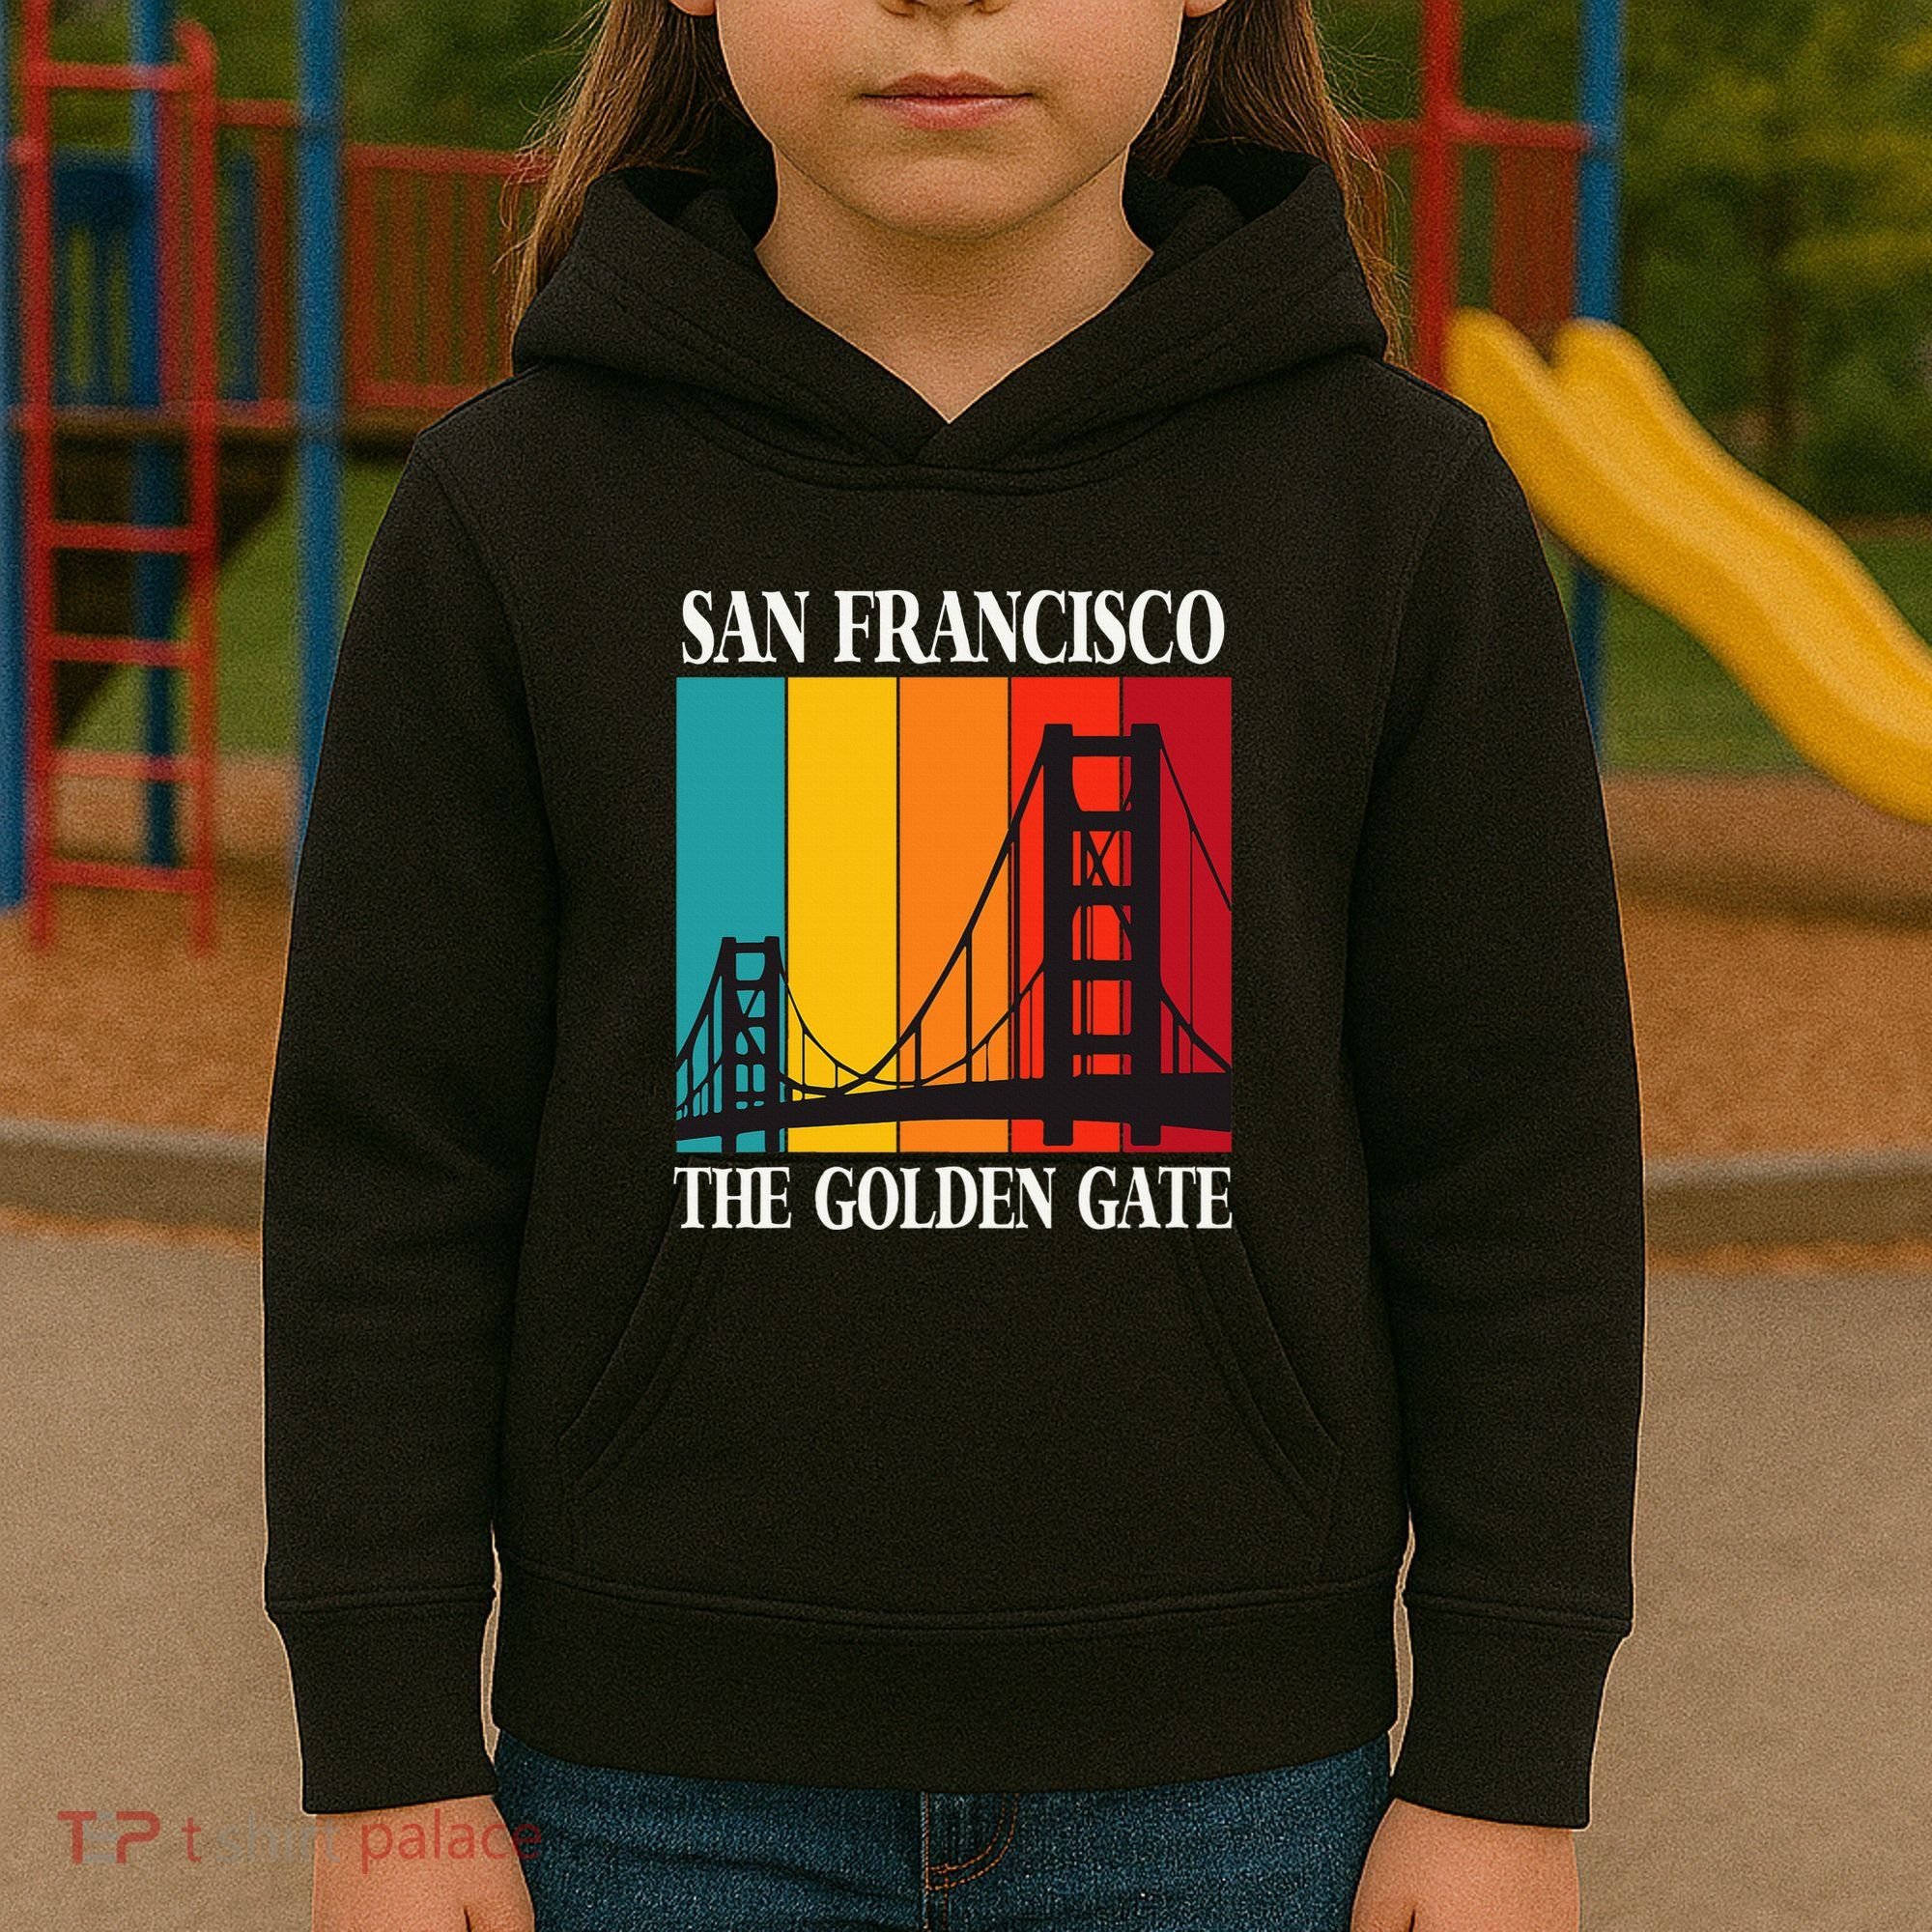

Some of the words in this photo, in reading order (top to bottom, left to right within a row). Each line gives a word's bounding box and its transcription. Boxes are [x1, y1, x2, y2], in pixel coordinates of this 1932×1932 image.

[683, 589, 810, 665] SAN
[834, 589, 1225, 665] FRANCISCO
[673, 1166, 792, 1229] THE
[814, 1166, 1057, 1230] GOLDEN
[1078, 1166, 1233, 1229] GATE
